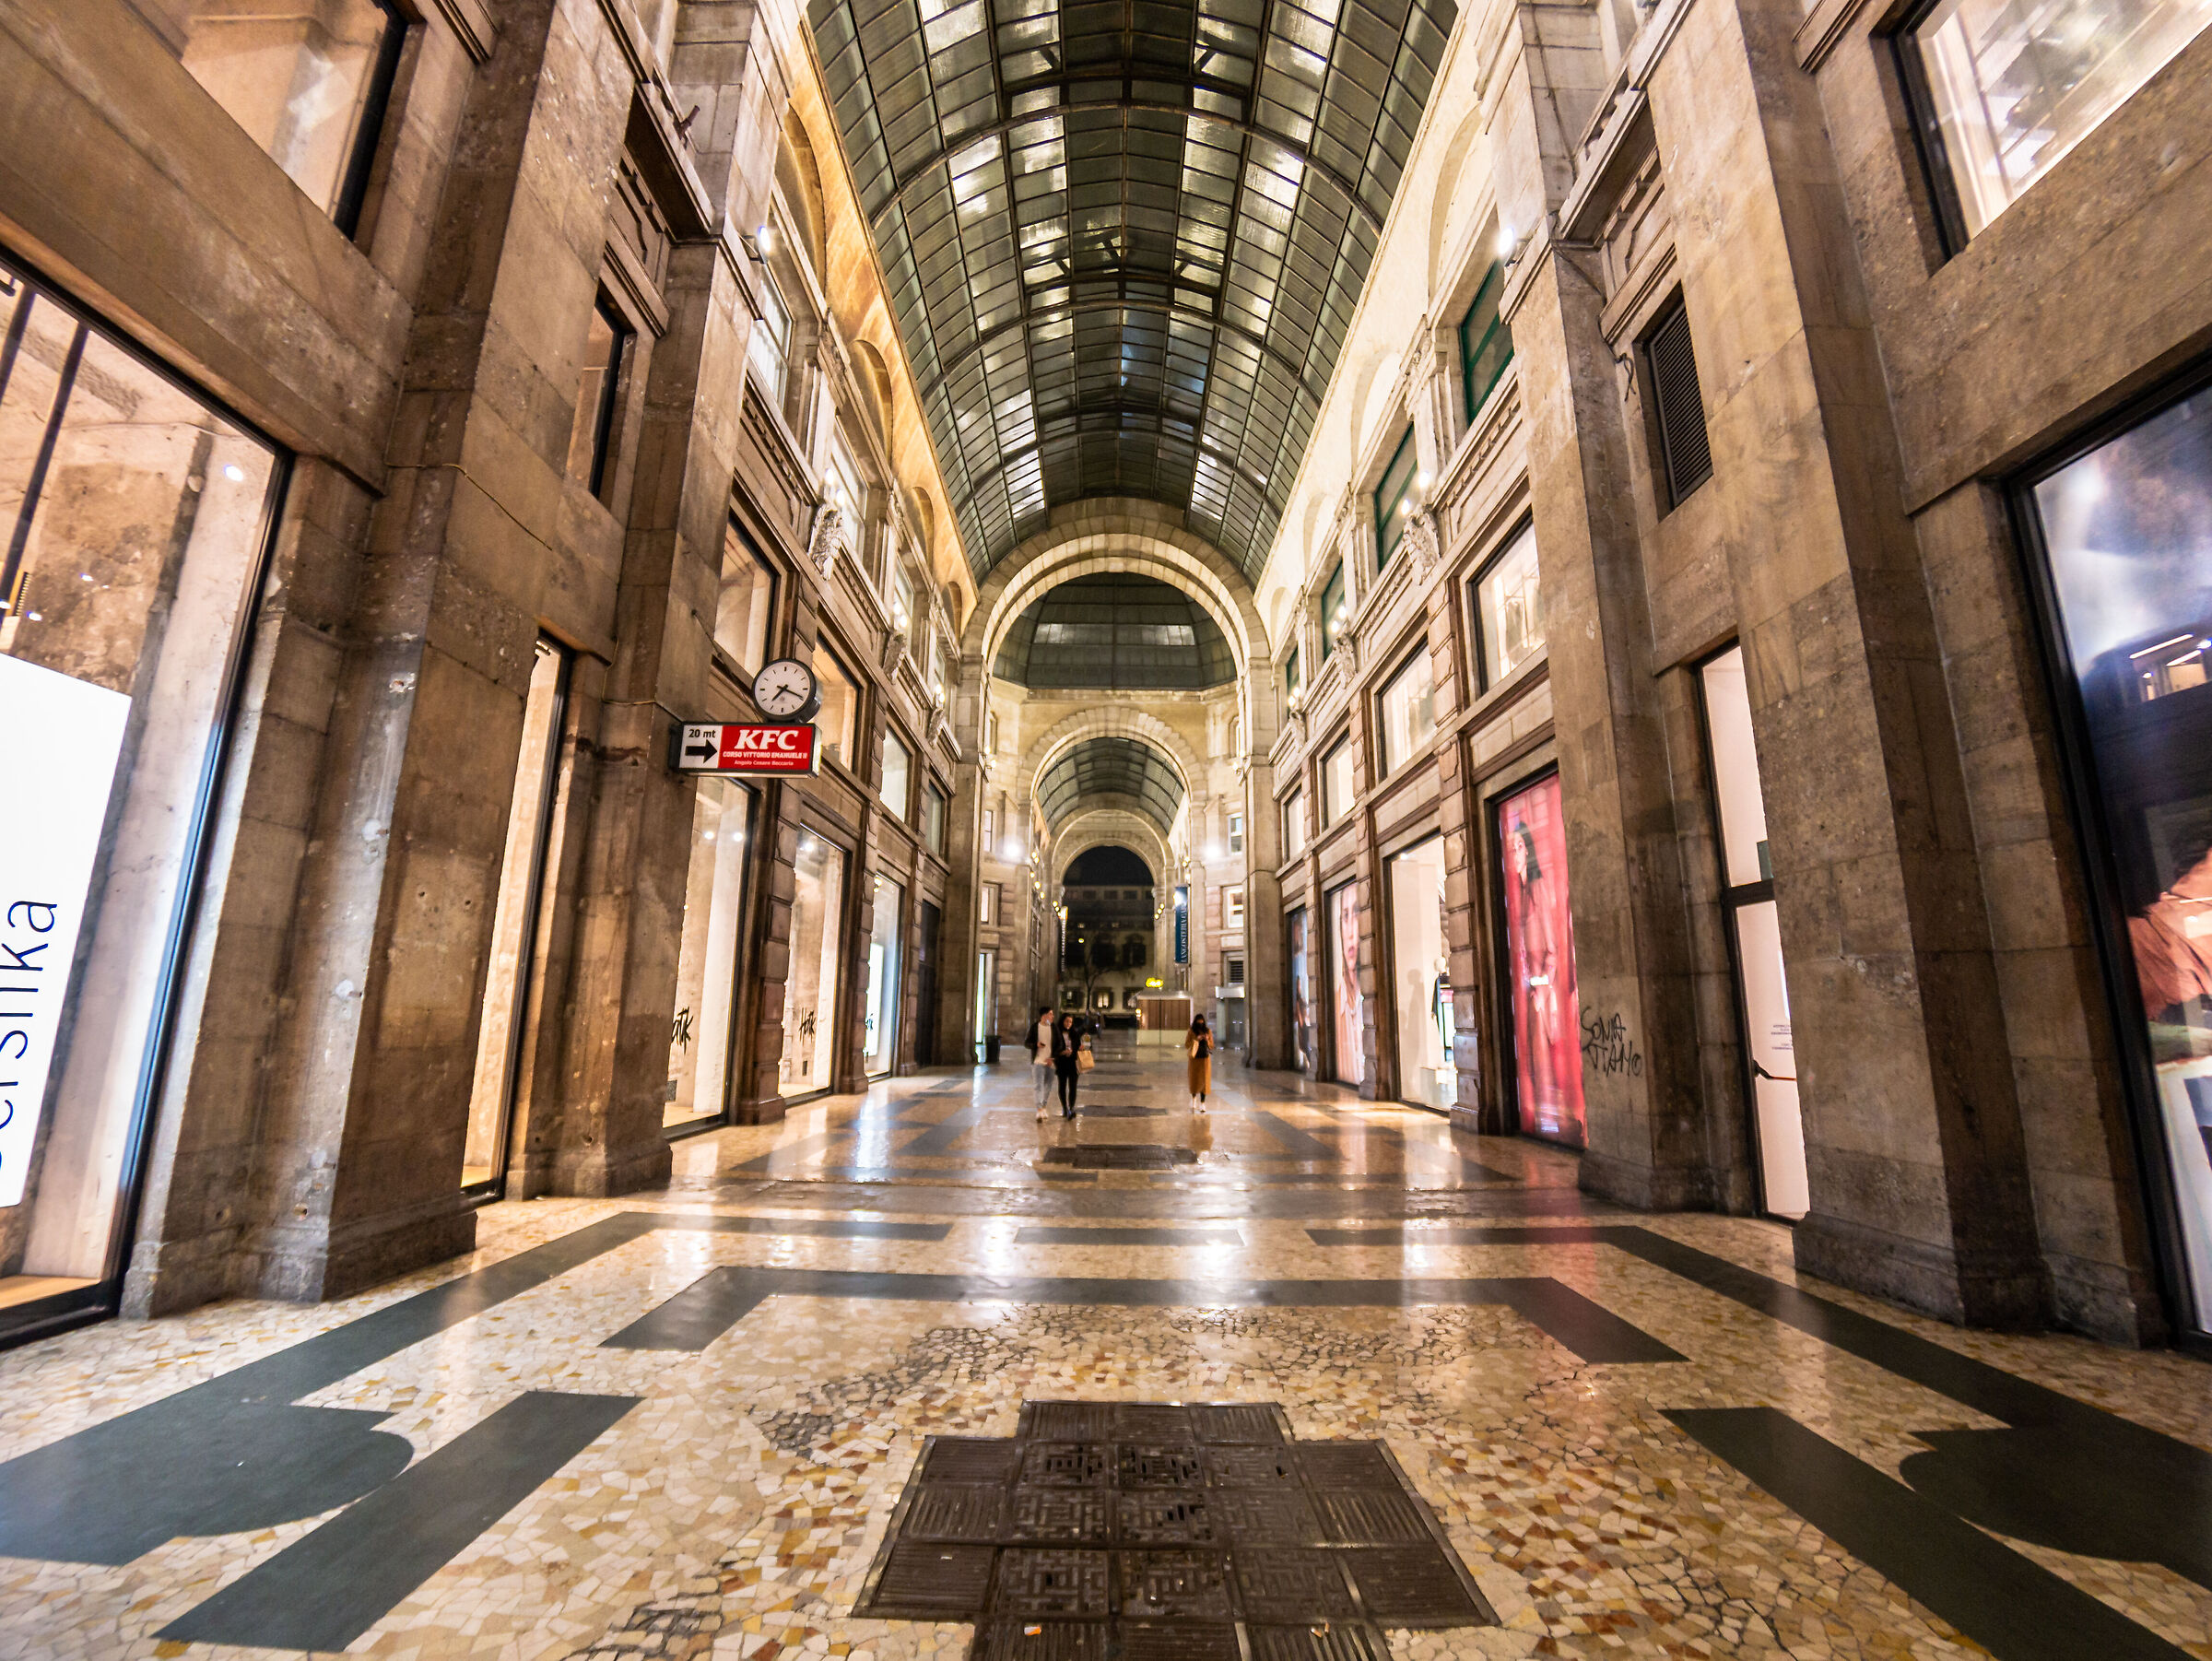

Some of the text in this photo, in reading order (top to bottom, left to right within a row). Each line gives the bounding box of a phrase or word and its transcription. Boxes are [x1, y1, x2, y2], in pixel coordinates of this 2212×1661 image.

[688, 728, 716, 738] 20 mt
[734, 729, 799, 750] KFC
